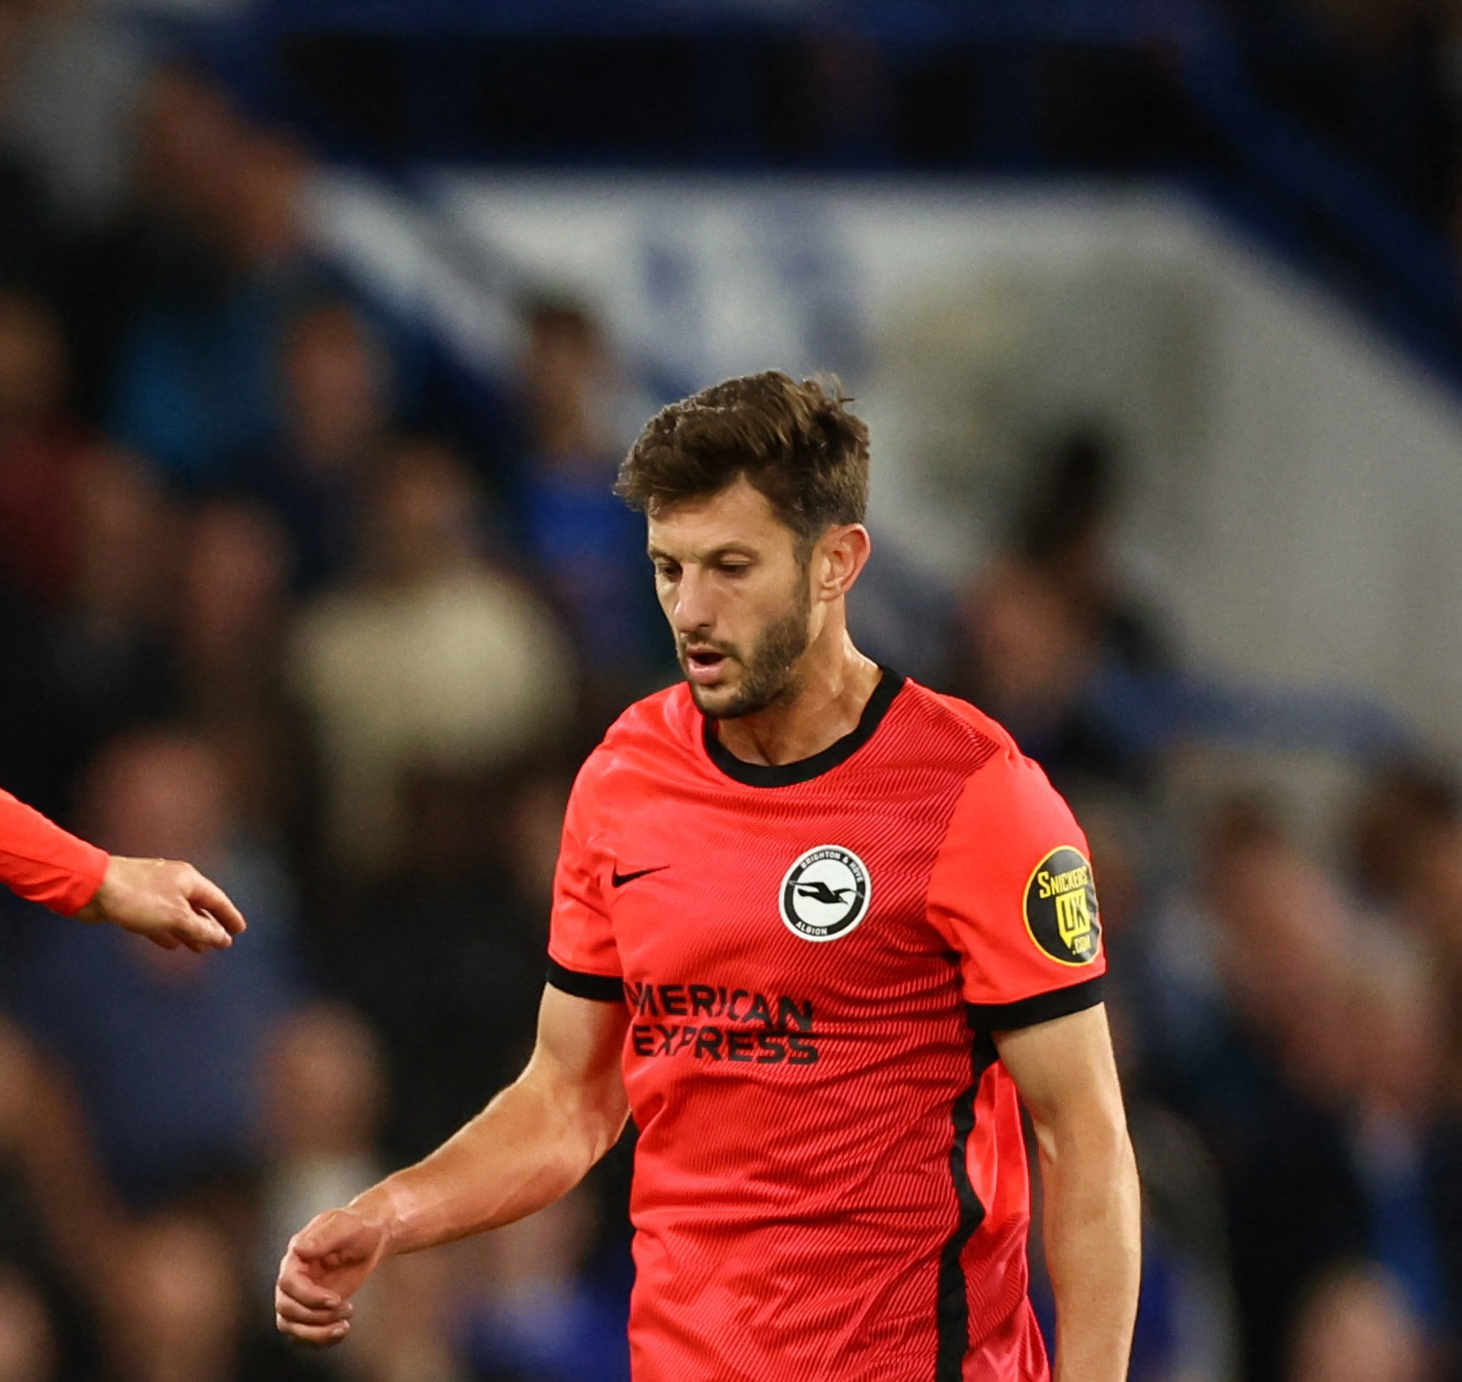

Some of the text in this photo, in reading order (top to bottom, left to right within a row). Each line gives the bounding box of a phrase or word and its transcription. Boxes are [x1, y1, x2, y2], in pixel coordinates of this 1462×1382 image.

[796, 921, 828, 936] ALBION
[1060, 893, 1086, 932] UK
[624, 982, 815, 1032] MERICAN
[633, 1024, 820, 1066] EXPRESS
